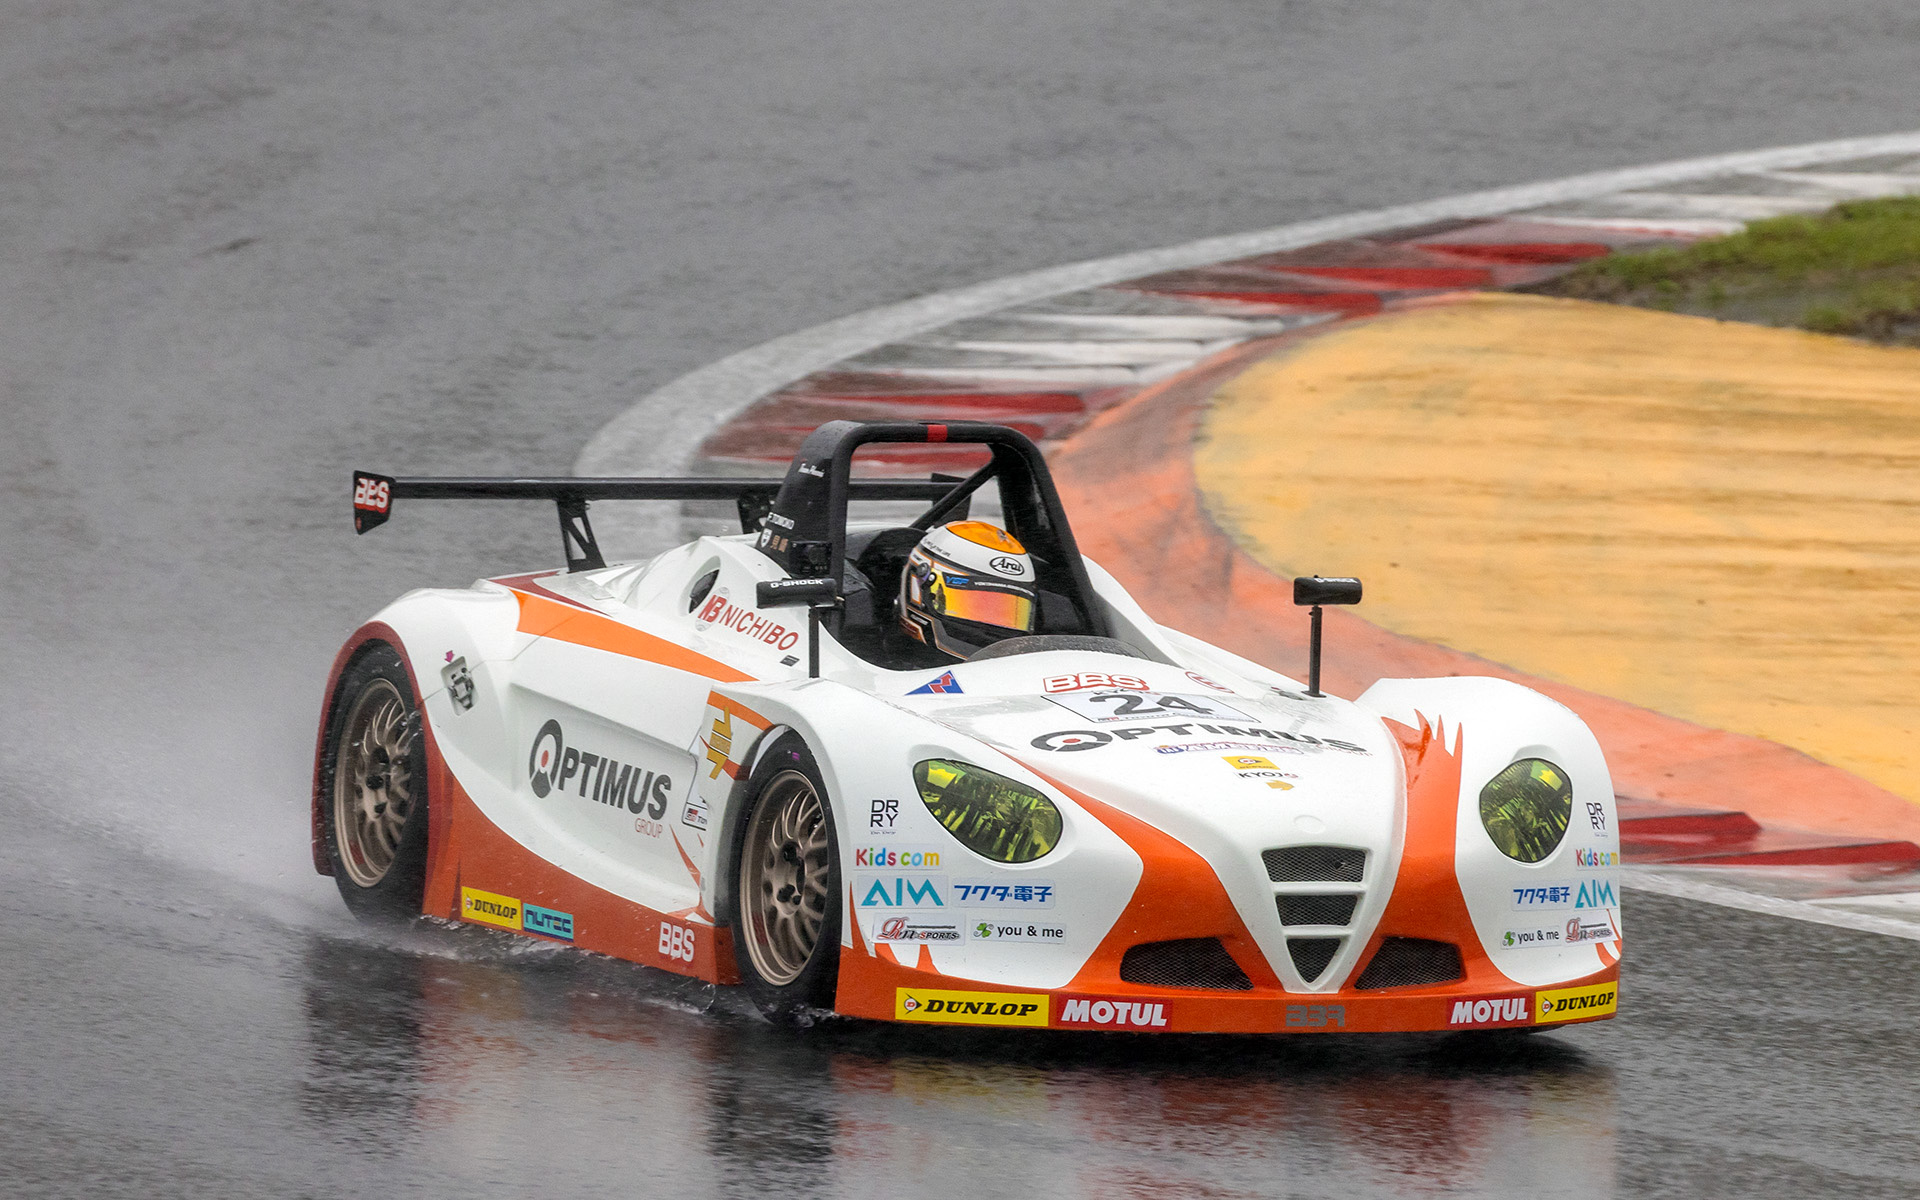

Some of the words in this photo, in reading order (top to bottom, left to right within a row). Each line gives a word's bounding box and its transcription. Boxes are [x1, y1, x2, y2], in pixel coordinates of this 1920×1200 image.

[993, 557, 1022, 572] Arai
[770, 578, 824, 589] G-SHOCK
[718, 604, 800, 651] NICHIBO
[1043, 671, 1150, 693] BBS
[1089, 694, 1216, 717] 24
[1030, 722, 1368, 753] OPTIMUS
[528, 718, 672, 822] OPTIMUS
[635, 818, 663, 838] GROUP
[855, 847, 897, 867] Kids
[900, 851, 940, 867] com
[1576, 847, 1599, 867] Kids
[1599, 851, 1619, 866] com
[861, 878, 944, 906] AIM
[953, 884, 1053, 903] フクダ電子
[1513, 886, 1571, 905] フクダ電子
[1574, 878, 1617, 909] AIM
[473, 898, 518, 919] DUNLOP
[658, 920, 696, 962] BBS
[997, 926, 1022, 938] you
[1027, 925, 1037, 937] &
[1041, 926, 1064, 938] me
[1517, 932, 1535, 944] you
[1537, 930, 1545, 941] &
[1546, 930, 1560, 941] me
[924, 999, 1039, 1017] DUNLOP
[1450, 997, 1529, 1024] MOTUL
[1555, 991, 1614, 1012] DUNLOP
[1060, 999, 1168, 1027] MOTUL
